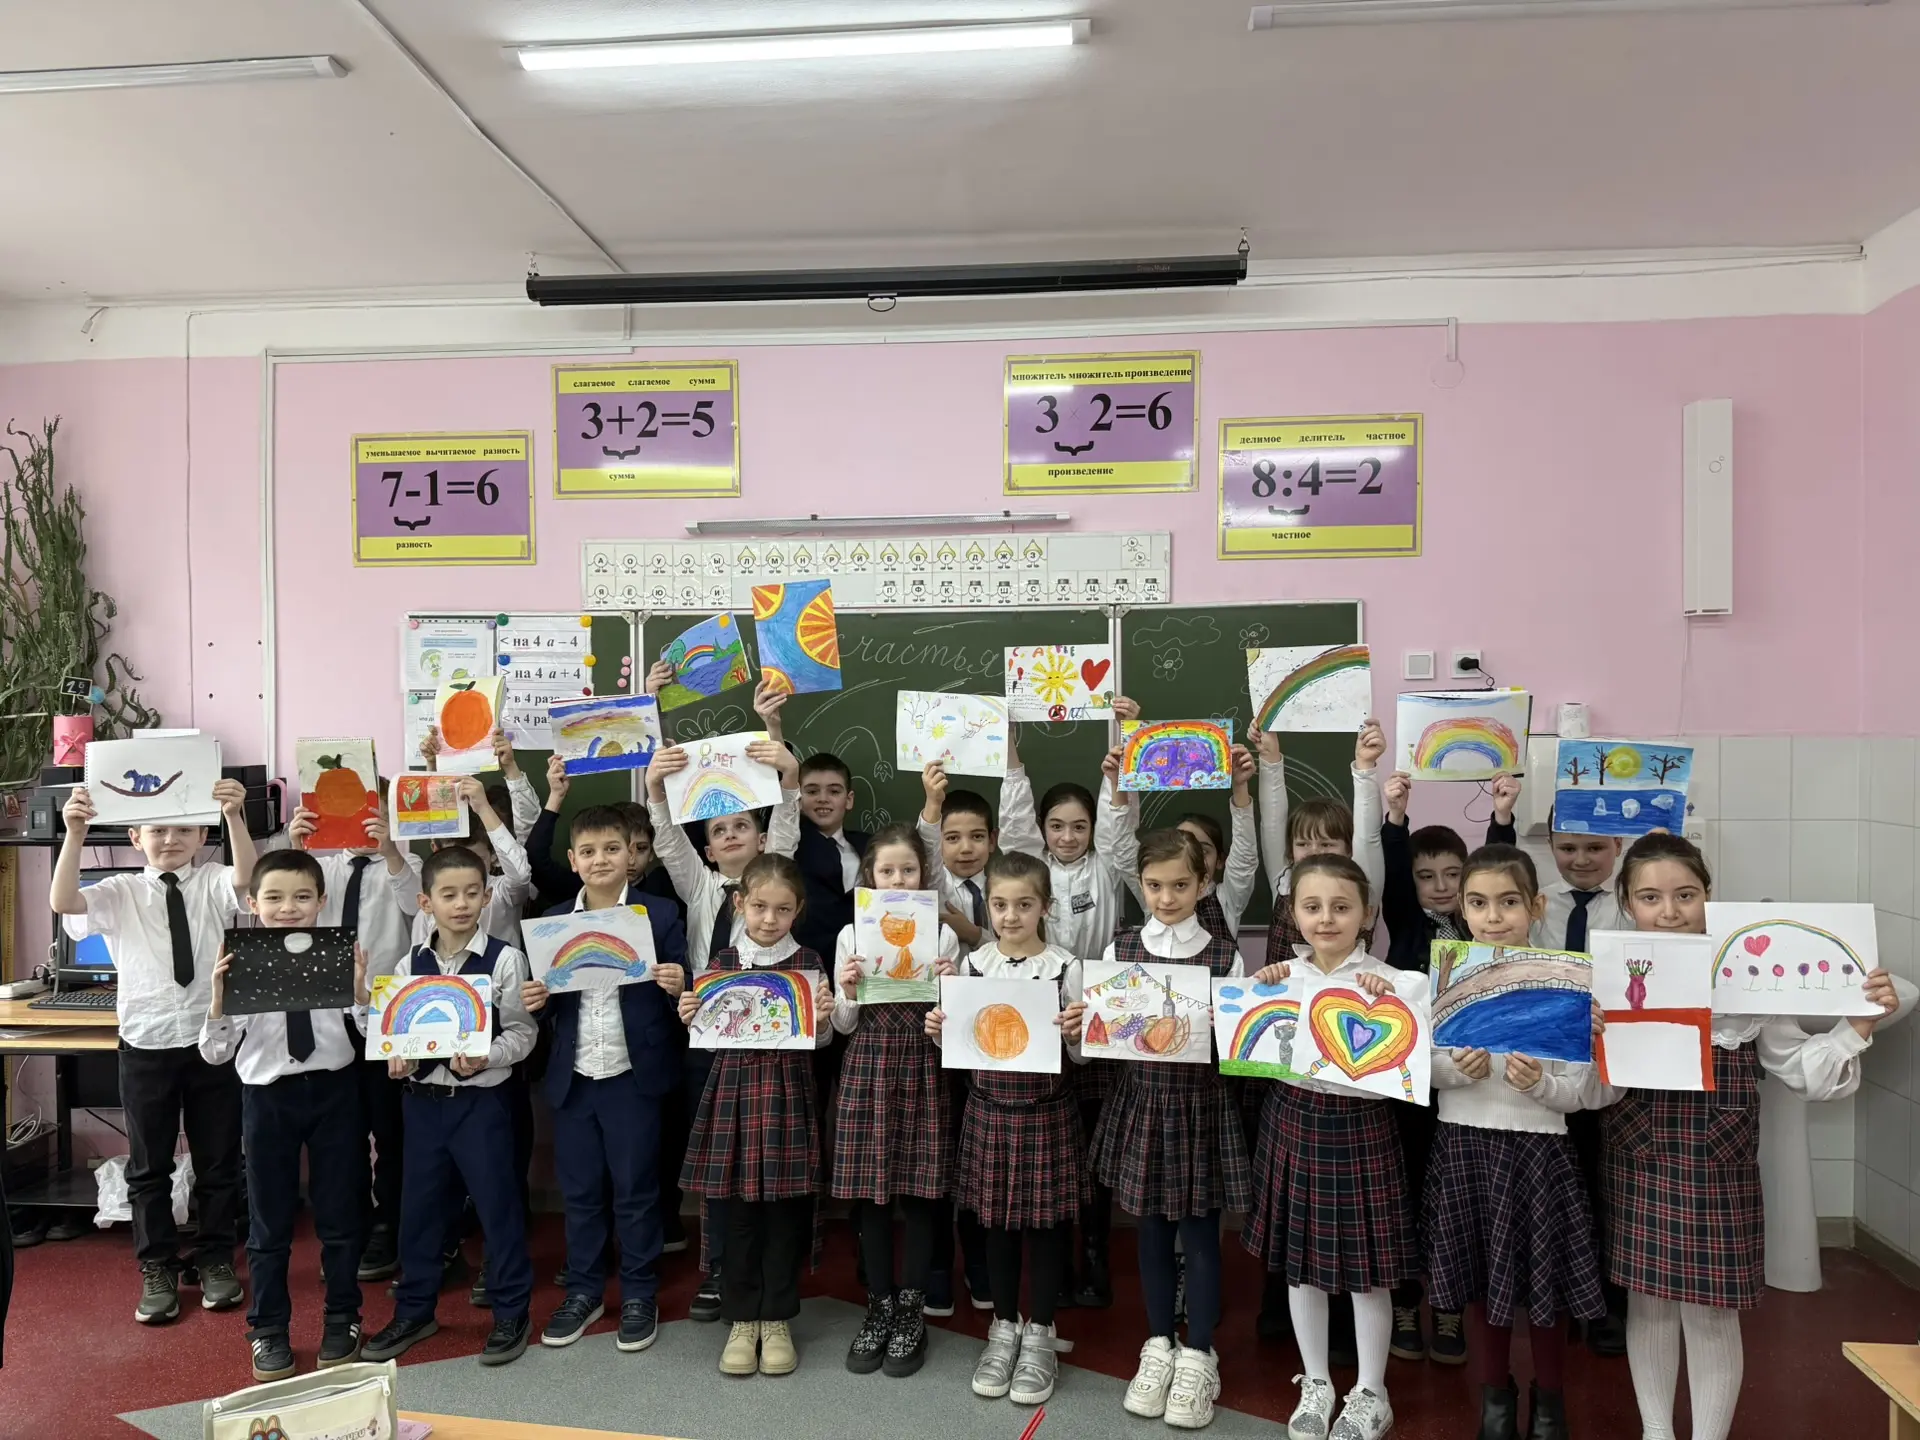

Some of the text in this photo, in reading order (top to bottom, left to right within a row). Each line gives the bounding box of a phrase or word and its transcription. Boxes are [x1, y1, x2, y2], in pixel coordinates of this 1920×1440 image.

[1012, 368, 1193, 381] множитель множитель произведение
[573, 378, 716, 389] слагаемое слагаемое сумма
[581, 400, 715, 440] 3+2=5
[1239, 431, 1406, 446] делимое делитель частное
[365, 447, 520, 459] уменьшаемое вычитаемое разность
[608, 472, 636, 482] сумма
[1048, 467, 1114, 479] произведение
[1251, 457, 1383, 498] 8:4=2
[381, 468, 500, 508] 7-1=6
[1271, 530, 1312, 541] частное
[396, 541, 433, 551] разность
[513, 638, 529, 647] на
[533, 635, 541, 647] 4
[570, 635, 578, 647] 4
[839, 633, 1004, 678] частья
[515, 669, 531, 679] на
[535, 667, 543, 679] 4
[573, 667, 581, 679] 4
[524, 693, 531, 704] 4
[523, 713, 530, 725] 4
